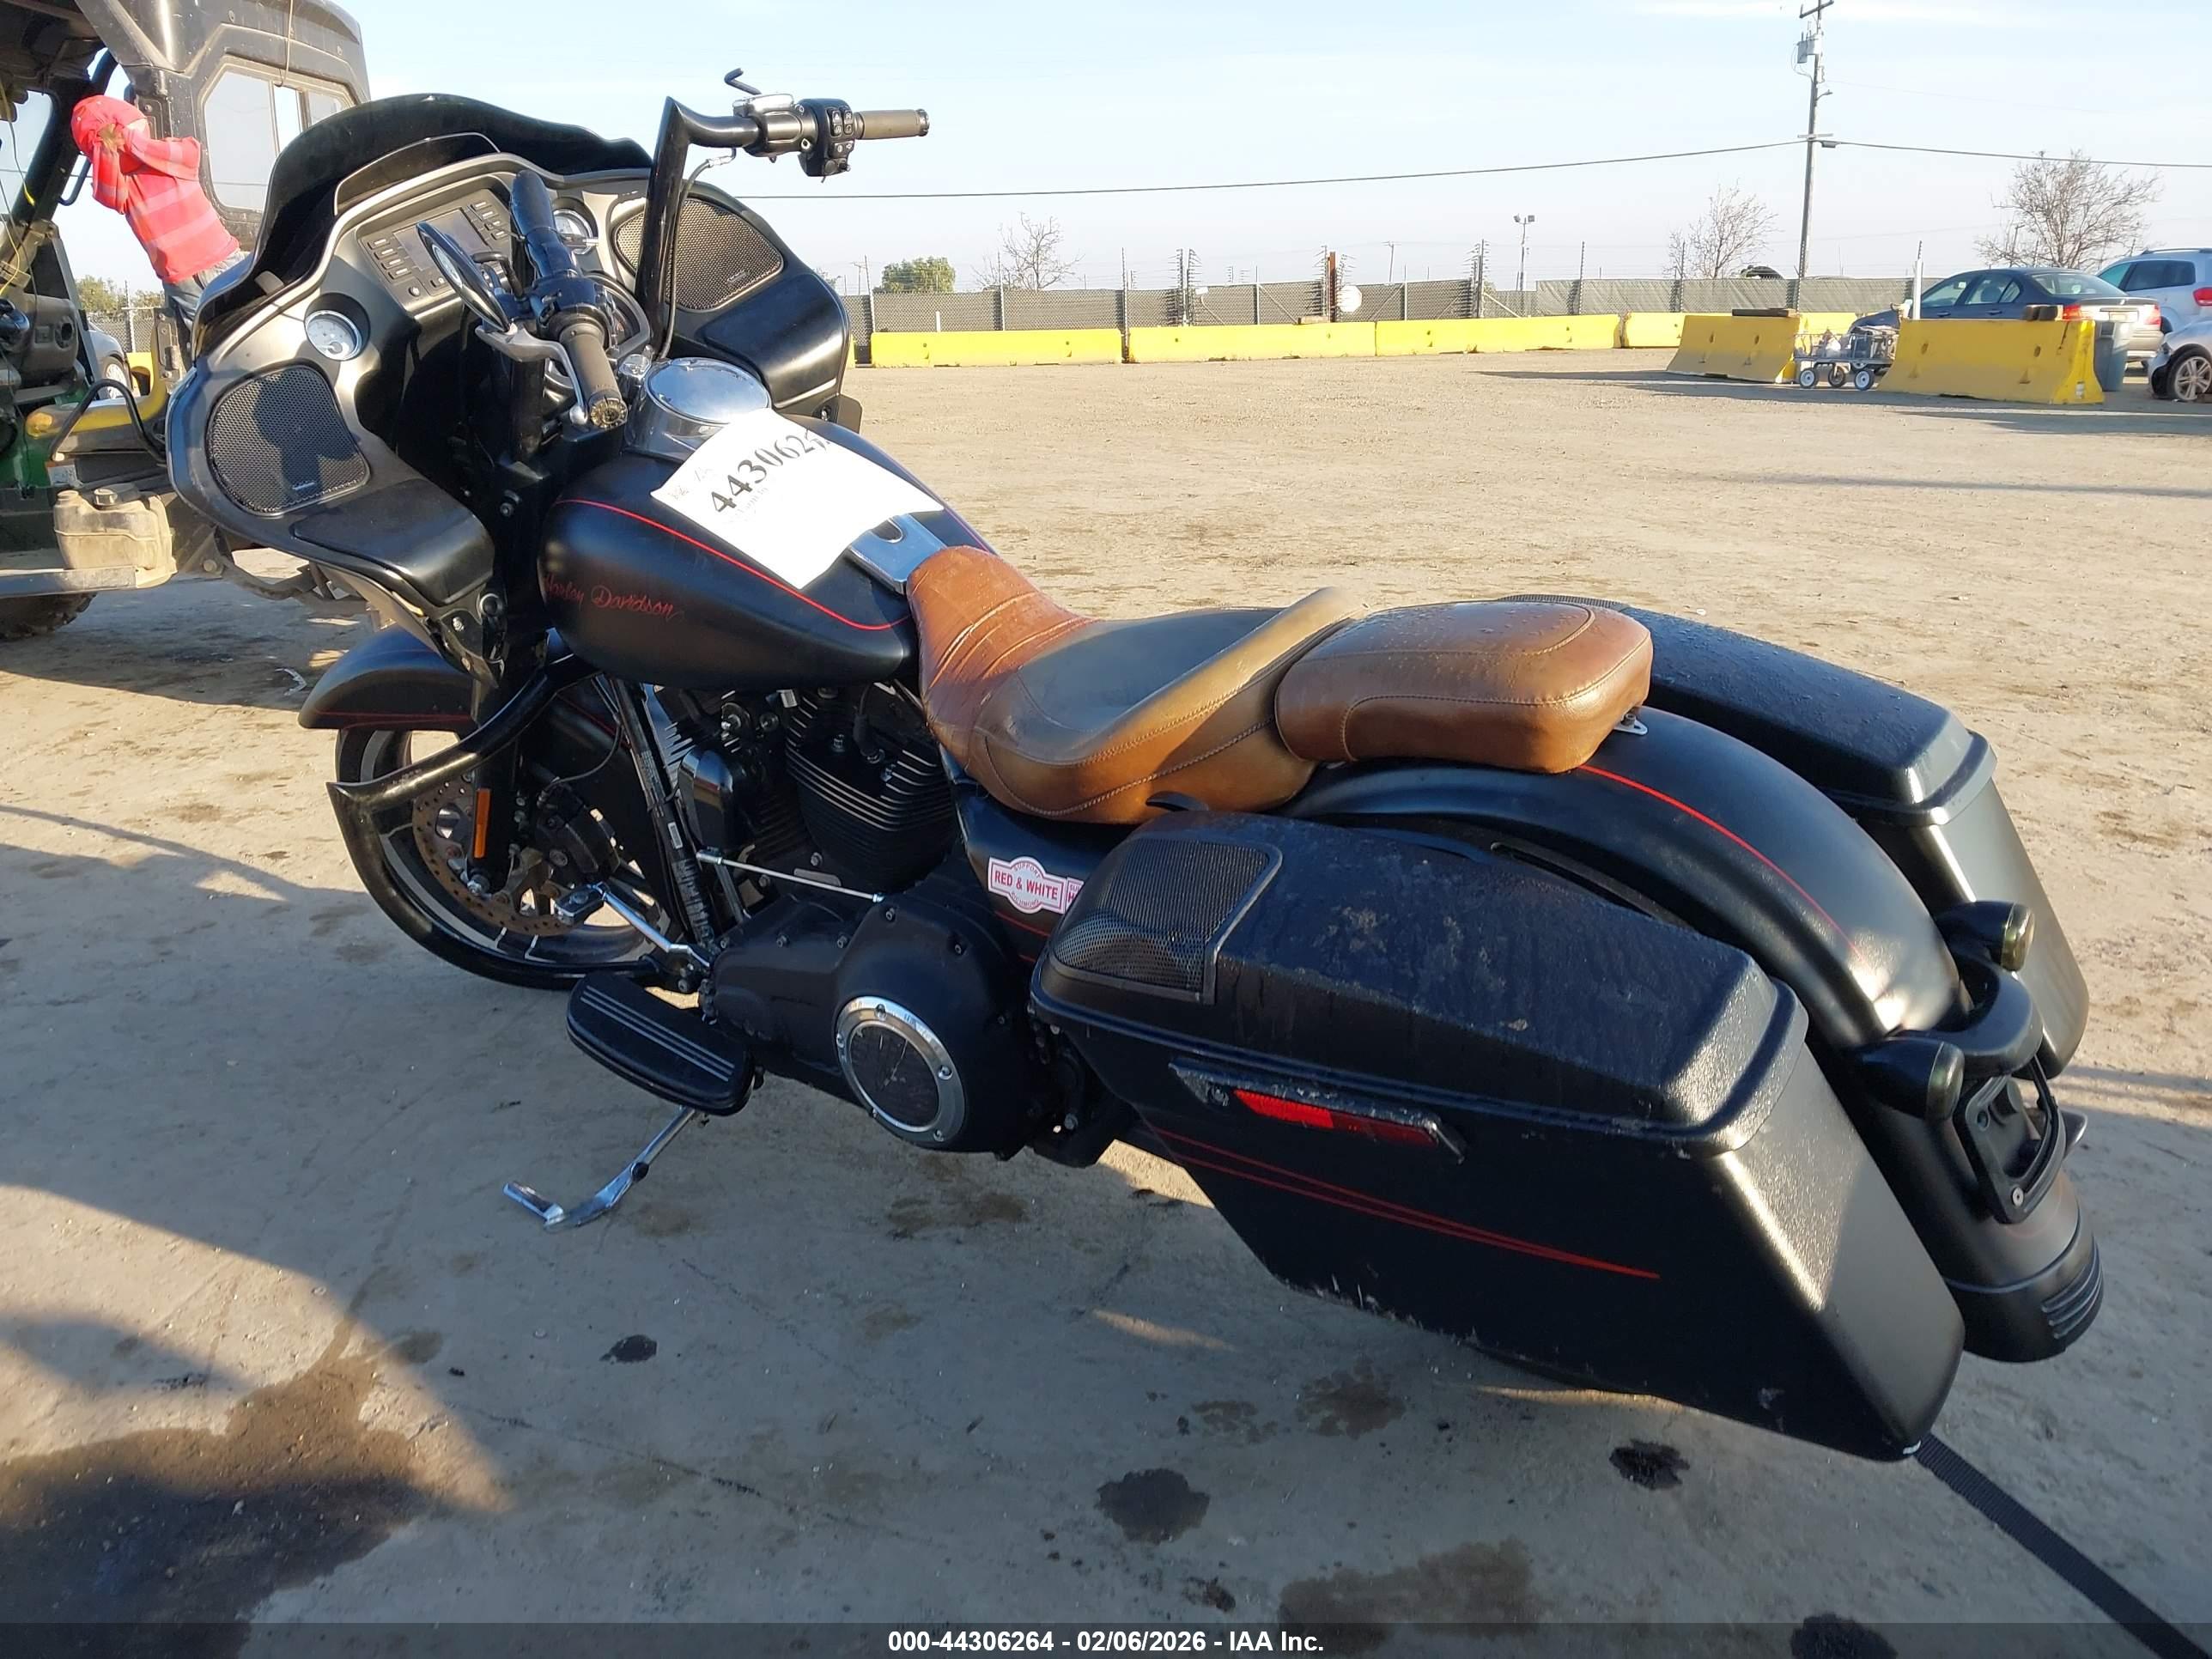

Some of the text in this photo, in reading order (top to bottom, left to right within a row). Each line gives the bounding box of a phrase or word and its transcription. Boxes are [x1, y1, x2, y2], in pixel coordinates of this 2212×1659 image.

[591, 585, 684, 622] Davidson
[994, 870, 1059, 900] RED & WHITE
